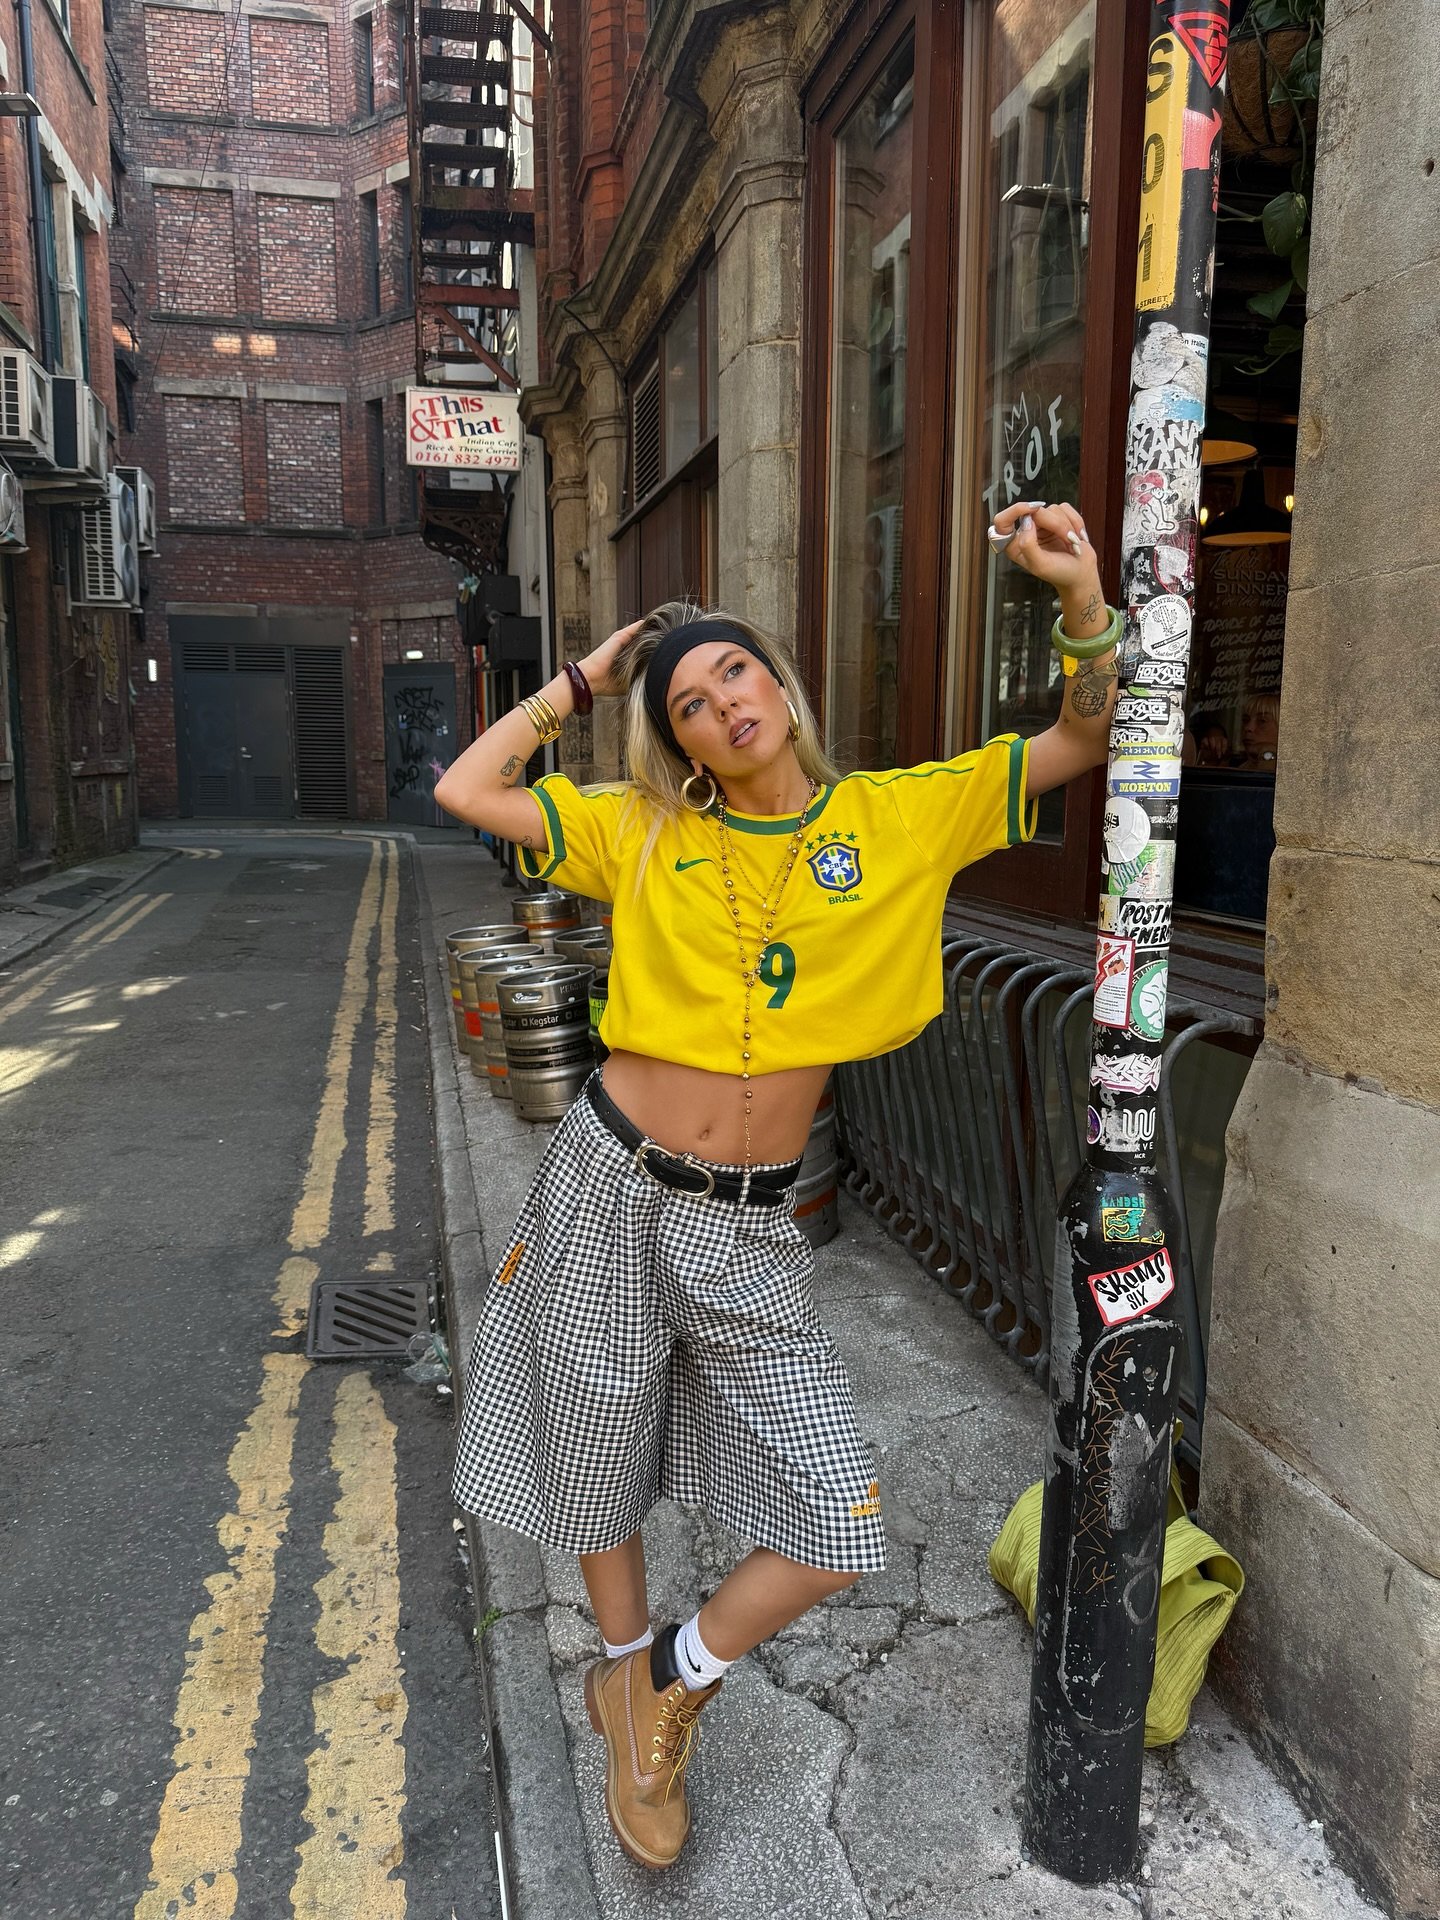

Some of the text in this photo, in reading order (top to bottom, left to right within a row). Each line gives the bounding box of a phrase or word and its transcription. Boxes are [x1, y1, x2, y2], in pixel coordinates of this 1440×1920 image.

[420, 395, 484, 417] This
[410, 409, 505, 442] & That
[466, 438, 518, 447] Indian Cafe
[459, 445, 483, 454] Three
[486, 447, 518, 455] Curries
[415, 451, 518, 467] 0161 832 4971
[1119, 782, 1172, 793] MORTON
[828, 894, 863, 905] BRASIL
[758, 942, 796, 1009] 9
[529, 1015, 559, 1028] Kegstar
[1126, 1285, 1149, 1310] SIX
